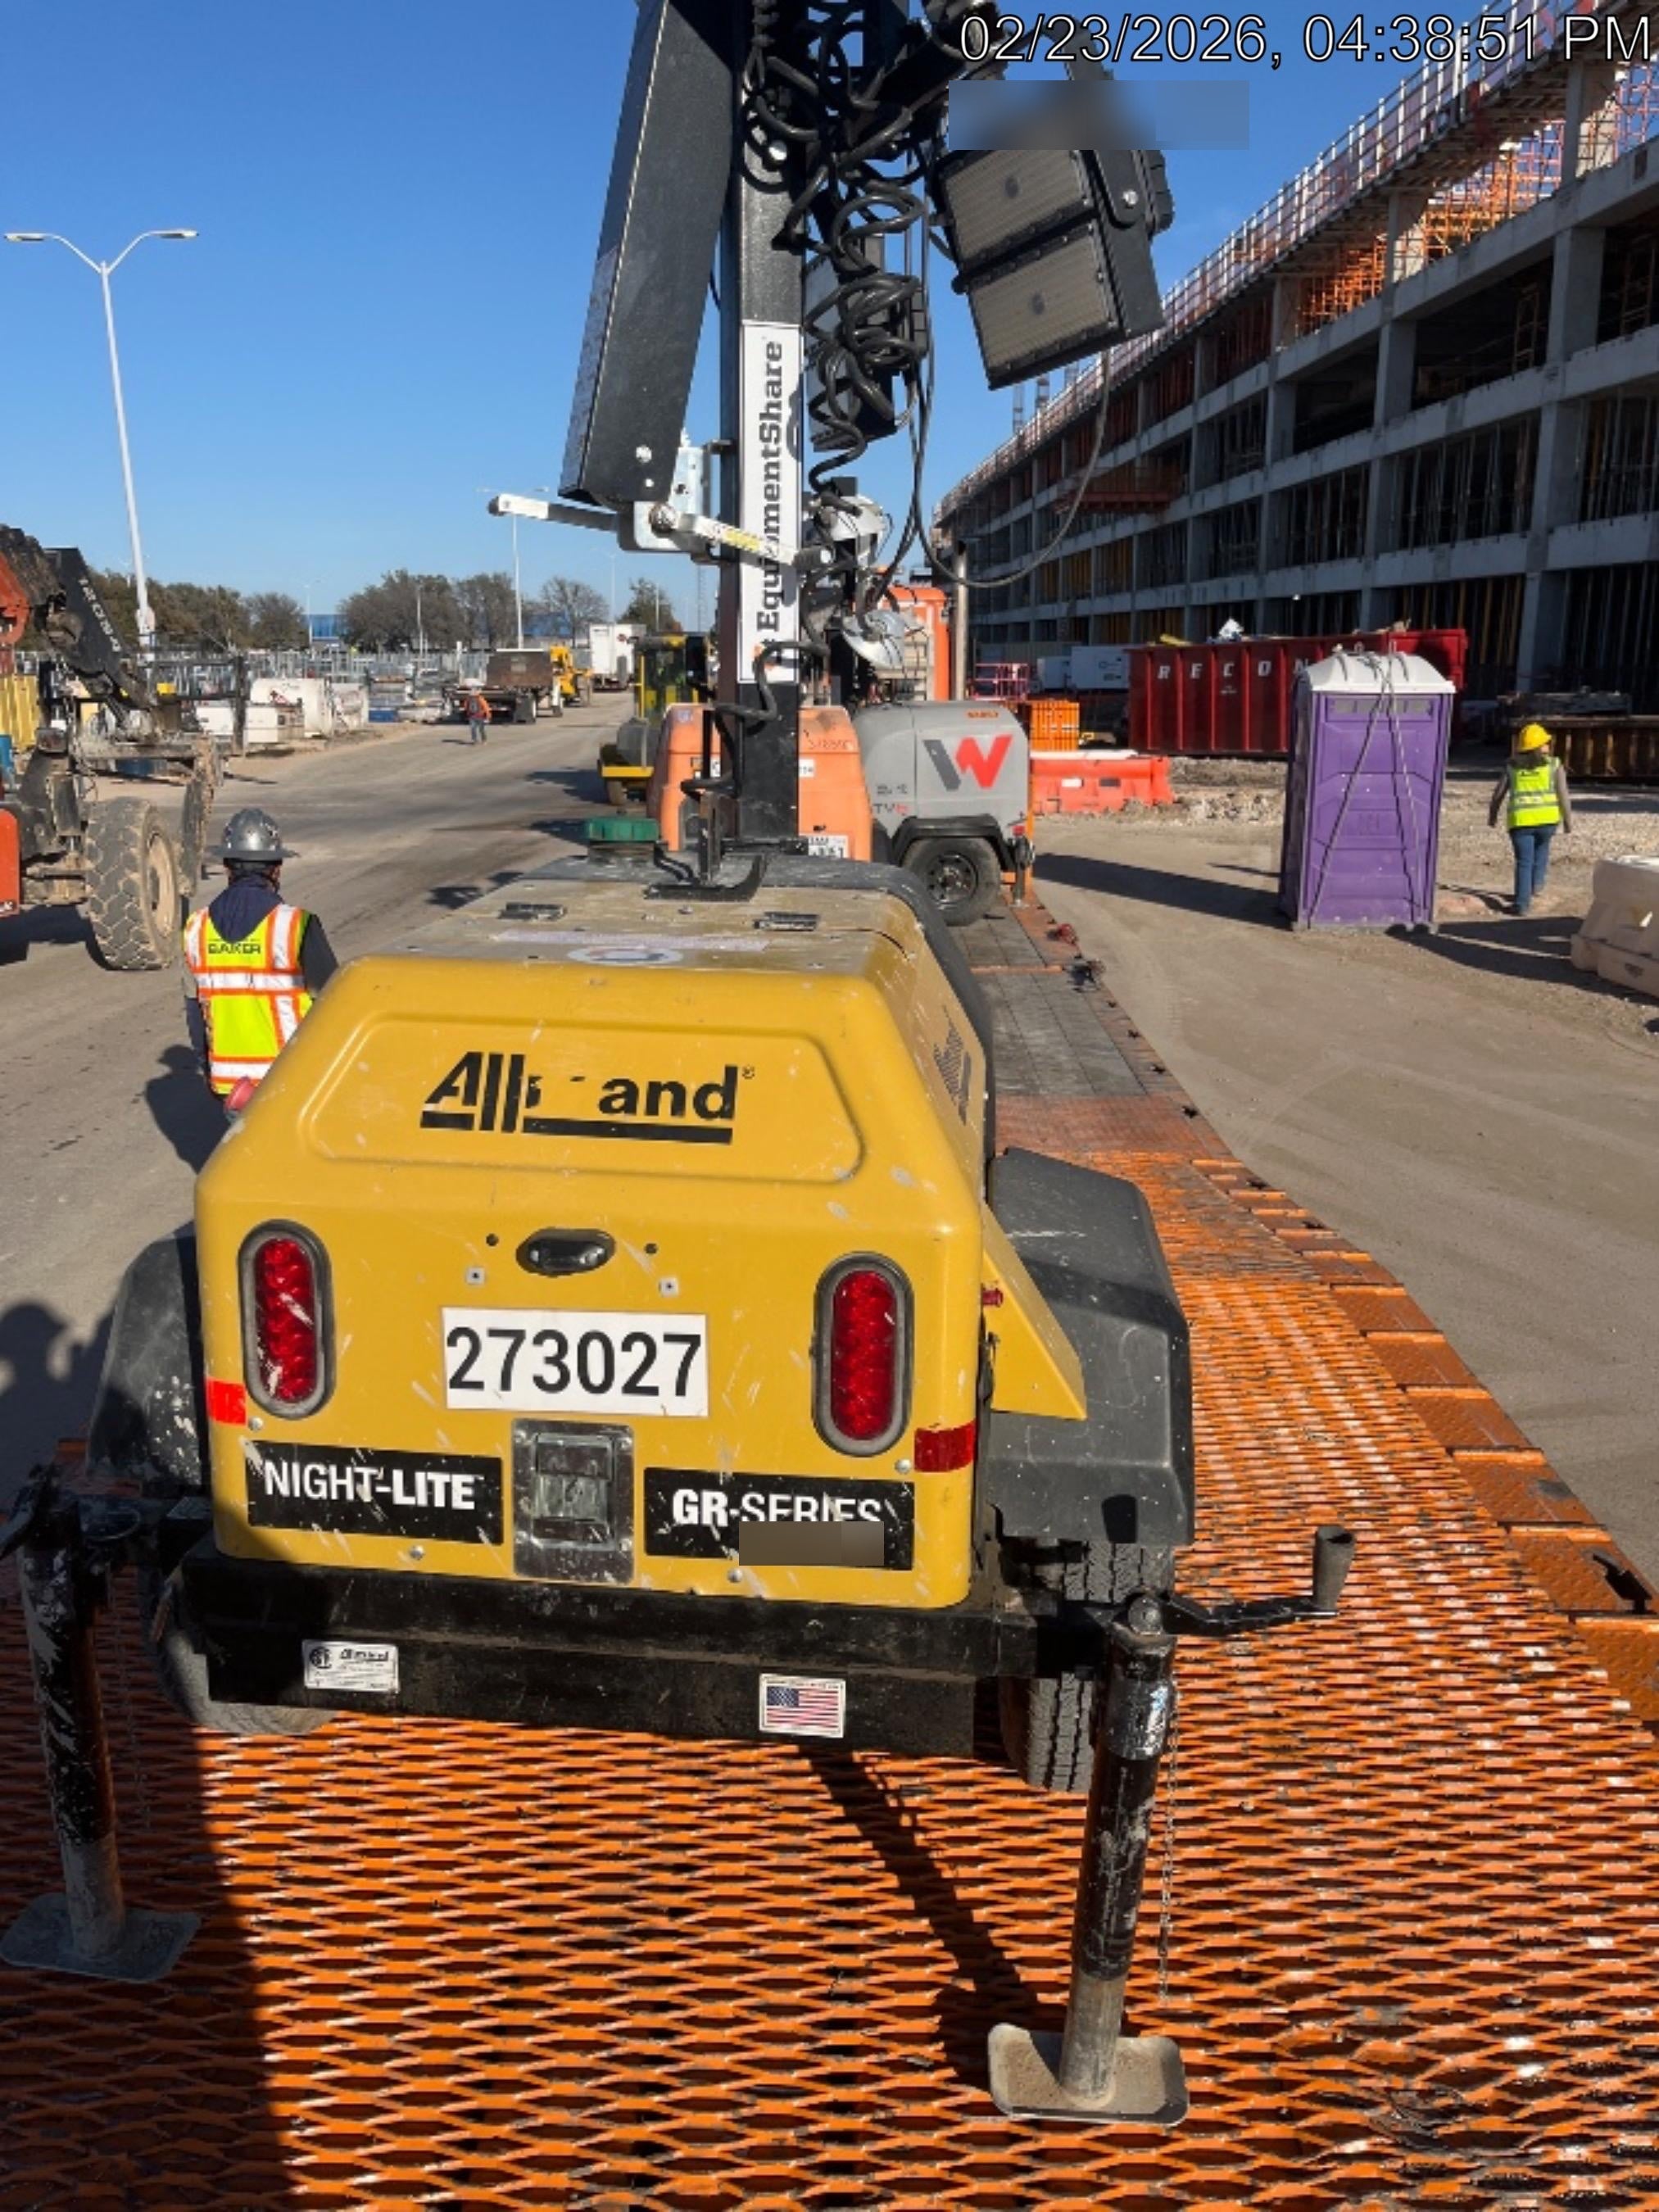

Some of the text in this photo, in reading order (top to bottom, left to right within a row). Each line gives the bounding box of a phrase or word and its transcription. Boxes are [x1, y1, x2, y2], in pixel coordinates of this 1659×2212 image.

[757, 341, 784, 632] EquimentShare
[420, 1051, 739, 1145] Alland
[446, 1326, 703, 1398] 273027
[264, 1459, 475, 1510] NIGHT-LITE
